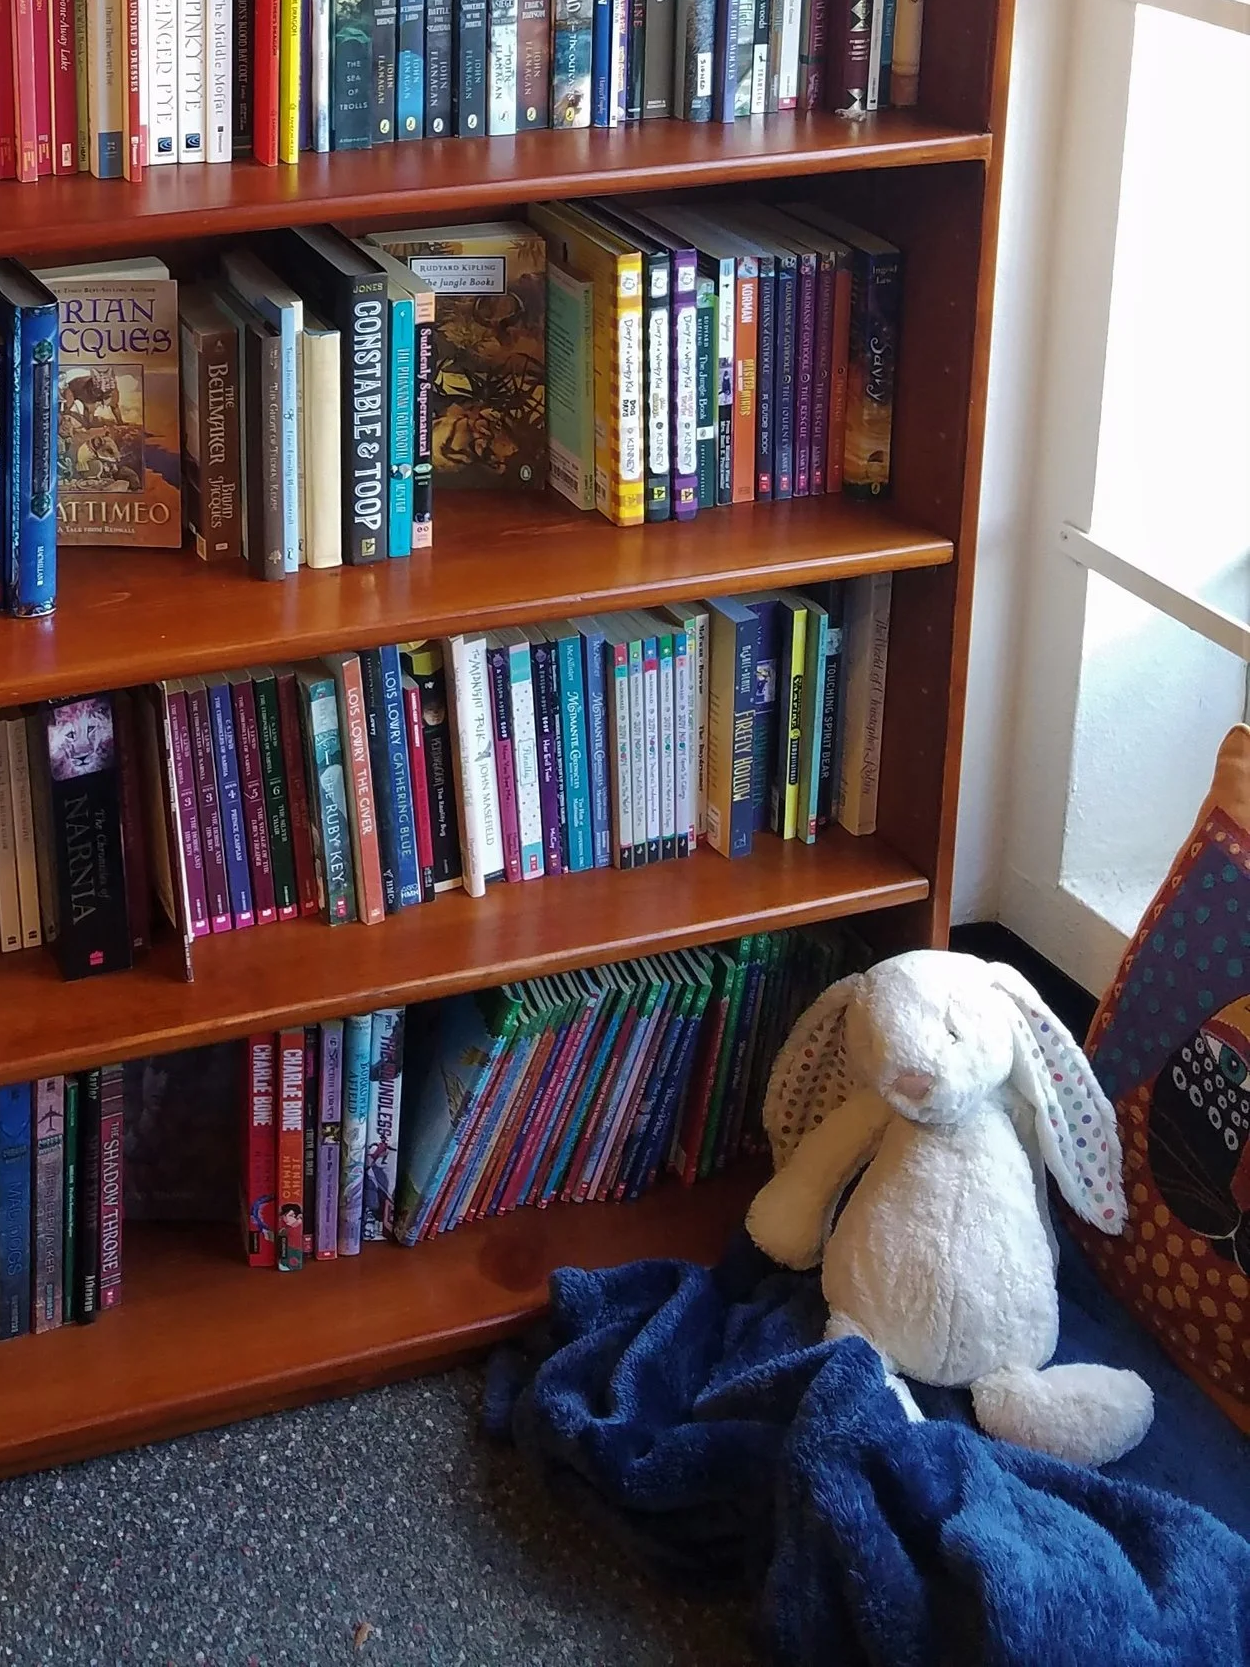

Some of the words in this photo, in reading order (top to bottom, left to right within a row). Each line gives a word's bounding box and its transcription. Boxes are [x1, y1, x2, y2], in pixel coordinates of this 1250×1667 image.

[185, 0, 202, 68] PINKY
[214, 18, 227, 69] Middle
[184, 72, 201, 112] PYE
[213, 72, 227, 116] Moffat
[339, 101, 369, 110] TROLLS
[353, 283, 384, 294] JONES
[437, 278, 465, 289] Jungle
[468, 277, 495, 287] Books
[62, 297, 156, 324] RIAN
[741, 283, 754, 324] KORMAN
[60, 328, 172, 354] CQUES
[353, 300, 382, 440] CONSTABLE
[357, 442, 380, 458] &
[57, 502, 170, 525] ATTIMEO
[354, 465, 382, 530] TOOP
[384, 670, 397, 700] LOIS
[825, 662, 837, 702] TOUCHING
[347, 687, 359, 720] LOIS
[823, 706, 834, 740] SPIRIT
[350, 723, 366, 764] LOWRY
[387, 704, 401, 746] LOWRY
[356, 769, 367, 791] THE
[820, 748, 830, 780] BEAR
[392, 752, 408, 821] GATHERING
[324, 805, 341, 849] RUBY
[359, 794, 373, 836] GIVER
[64, 793, 97, 926] NARNIA
[398, 824, 412, 856] BLUE
[330, 852, 345, 886] KEY
[253, 1044, 272, 1094] CHARLIE
[282, 1048, 303, 1098] CHARLIE
[253, 1096, 272, 1127] BONE
[282, 1100, 303, 1132] BONE
[104, 1138, 120, 1205] SHADOW
[102, 1208, 119, 1279] THRONE
